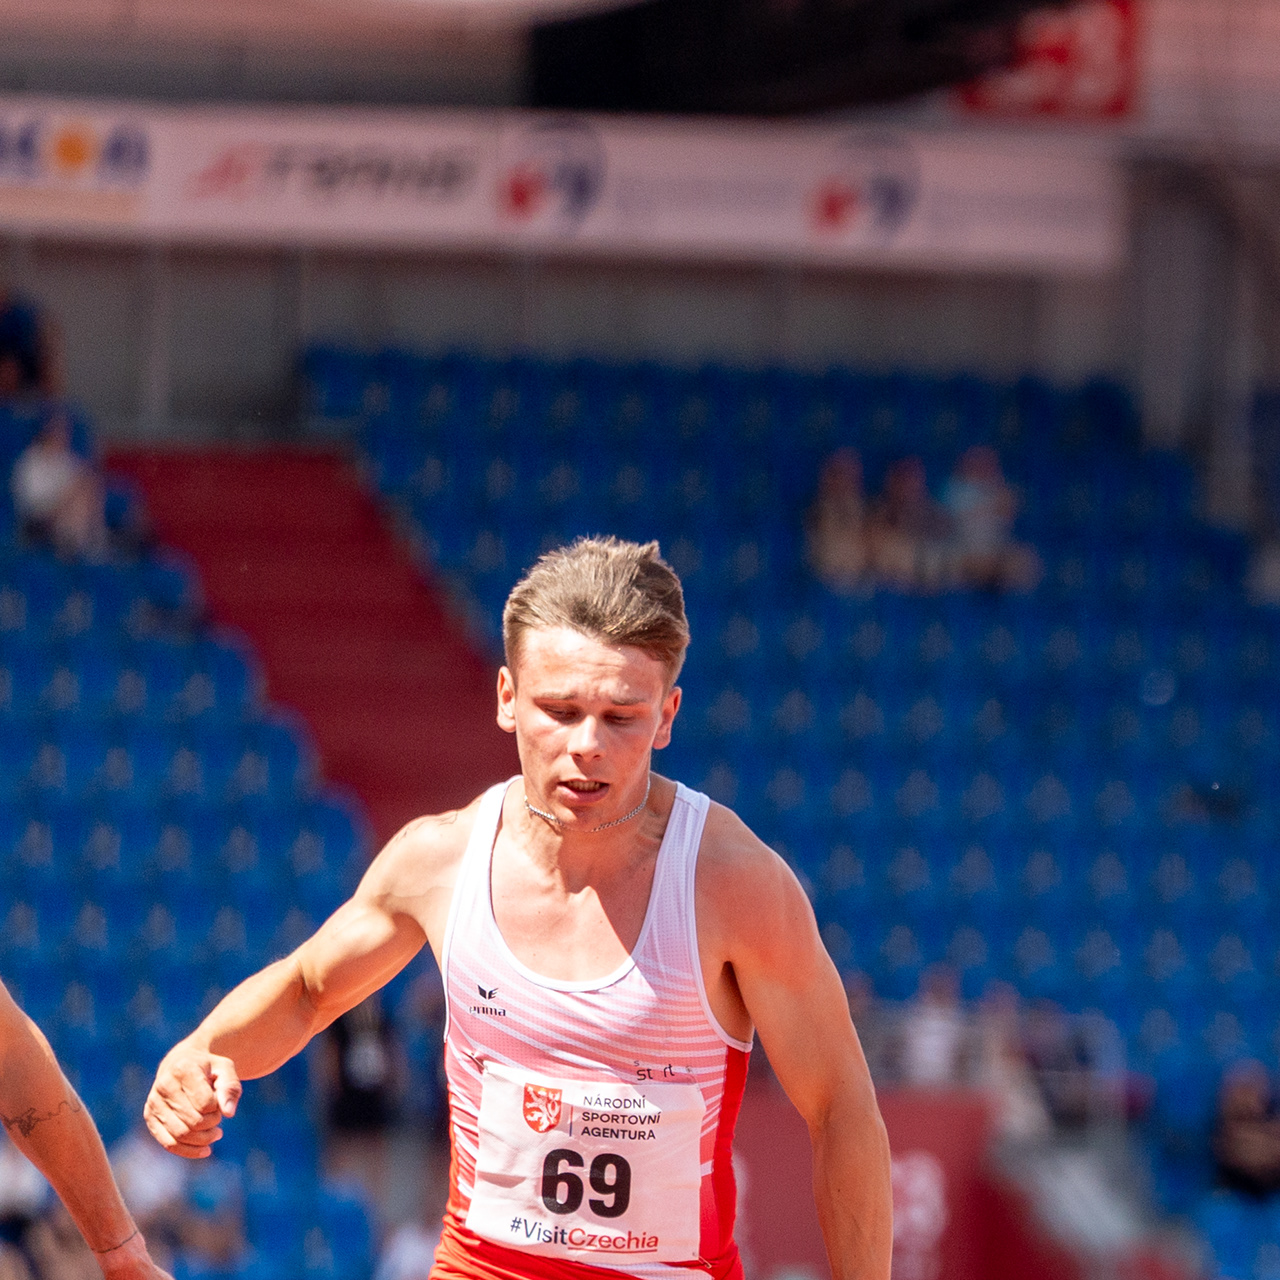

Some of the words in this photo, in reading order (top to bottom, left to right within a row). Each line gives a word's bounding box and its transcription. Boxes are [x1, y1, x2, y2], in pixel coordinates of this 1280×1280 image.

[583, 1094, 647, 1110] NÁRODNÍ
[581, 1110, 662, 1125] SPORTOVNÍ
[580, 1126, 657, 1141] AGENTURA
[540, 1147, 632, 1219] 69
[510, 1216, 660, 1250] #VisitCzechia
